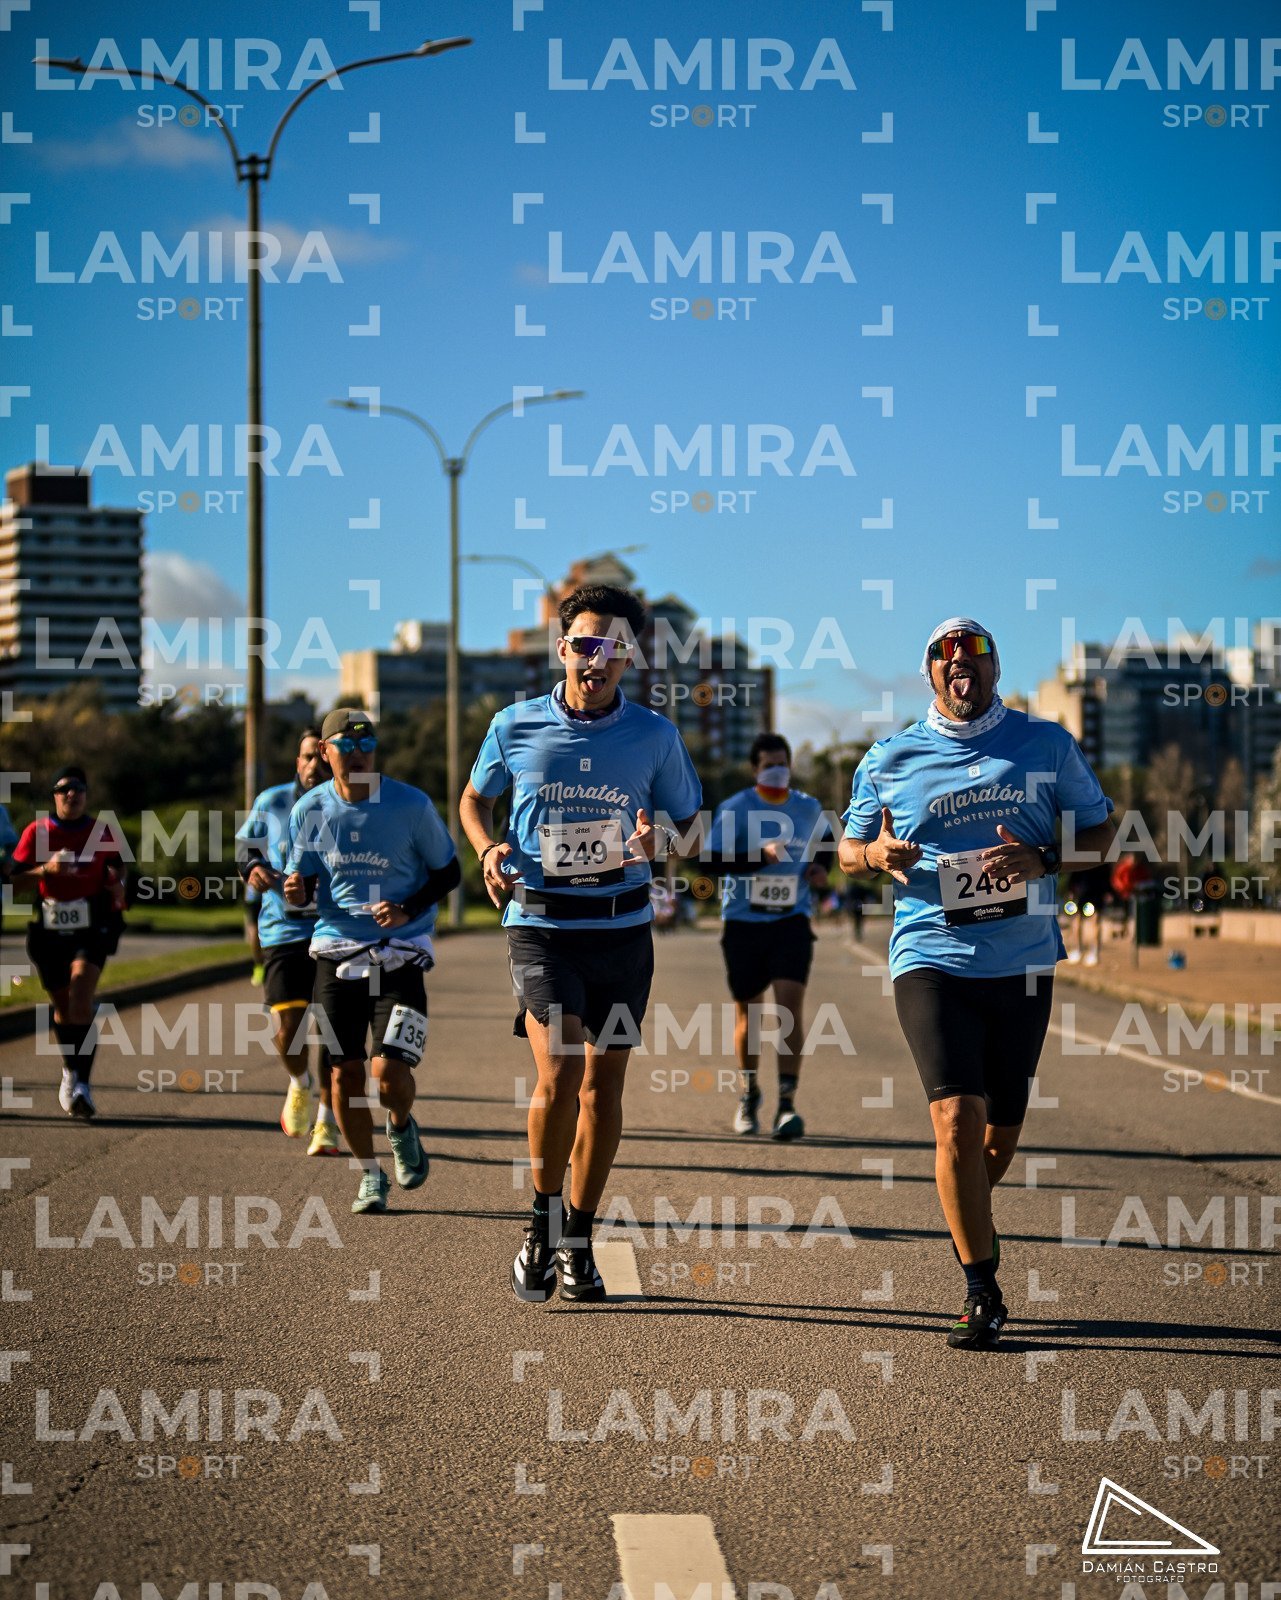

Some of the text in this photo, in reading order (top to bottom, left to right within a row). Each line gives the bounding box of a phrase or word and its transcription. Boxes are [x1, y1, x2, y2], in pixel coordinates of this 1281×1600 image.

[538, 782, 630, 807] Maratón
[928, 784, 1026, 818] Maratón
[548, 806, 622, 816] MONTEVIDEO
[944, 806, 1020, 829] MONTEVIDEO
[555, 840, 608, 868] 249
[760, 886, 790, 900] 499
[51, 910, 79, 924] 208
[394, 1022, 427, 1053] 135
